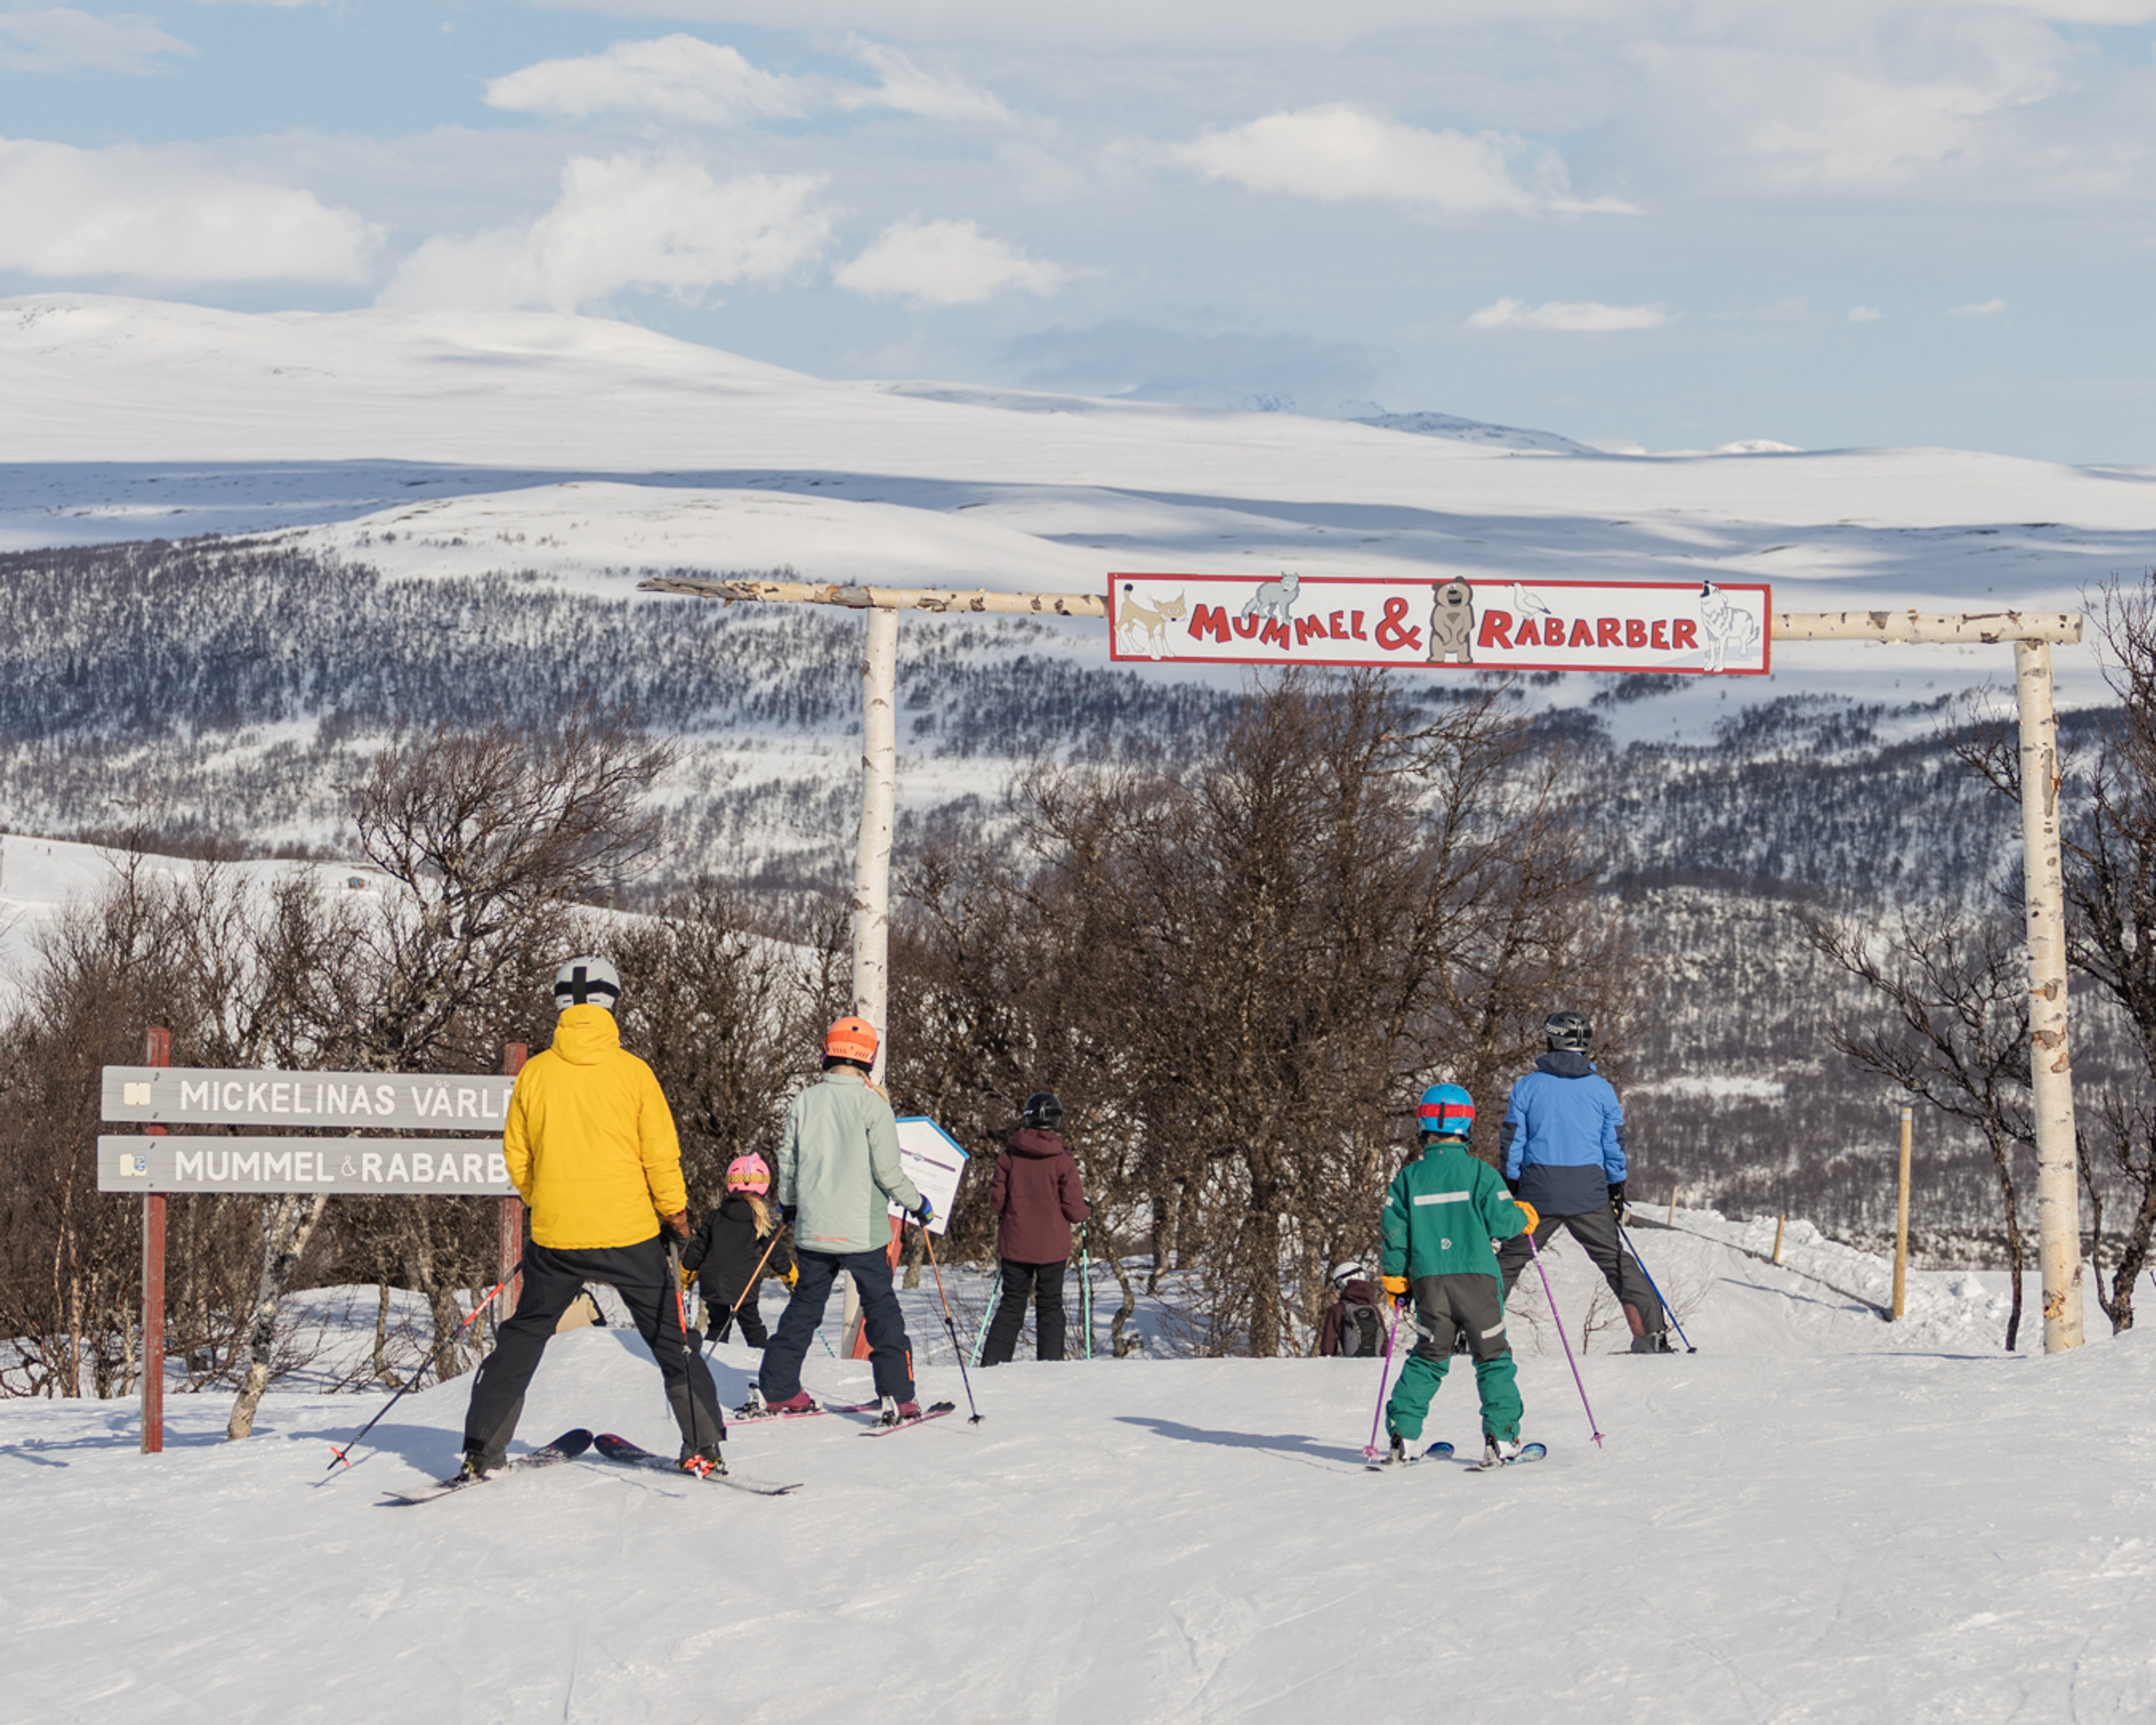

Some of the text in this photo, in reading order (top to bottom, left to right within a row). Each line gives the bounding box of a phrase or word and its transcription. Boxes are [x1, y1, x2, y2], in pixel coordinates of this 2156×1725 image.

[1188, 597, 1699, 650] MUMMEL & RABARBER
[180, 1080, 395, 1115] MICKELINAS
[175, 1151, 335, 1182] MUMMEL
[342, 1155, 357, 1177] &
